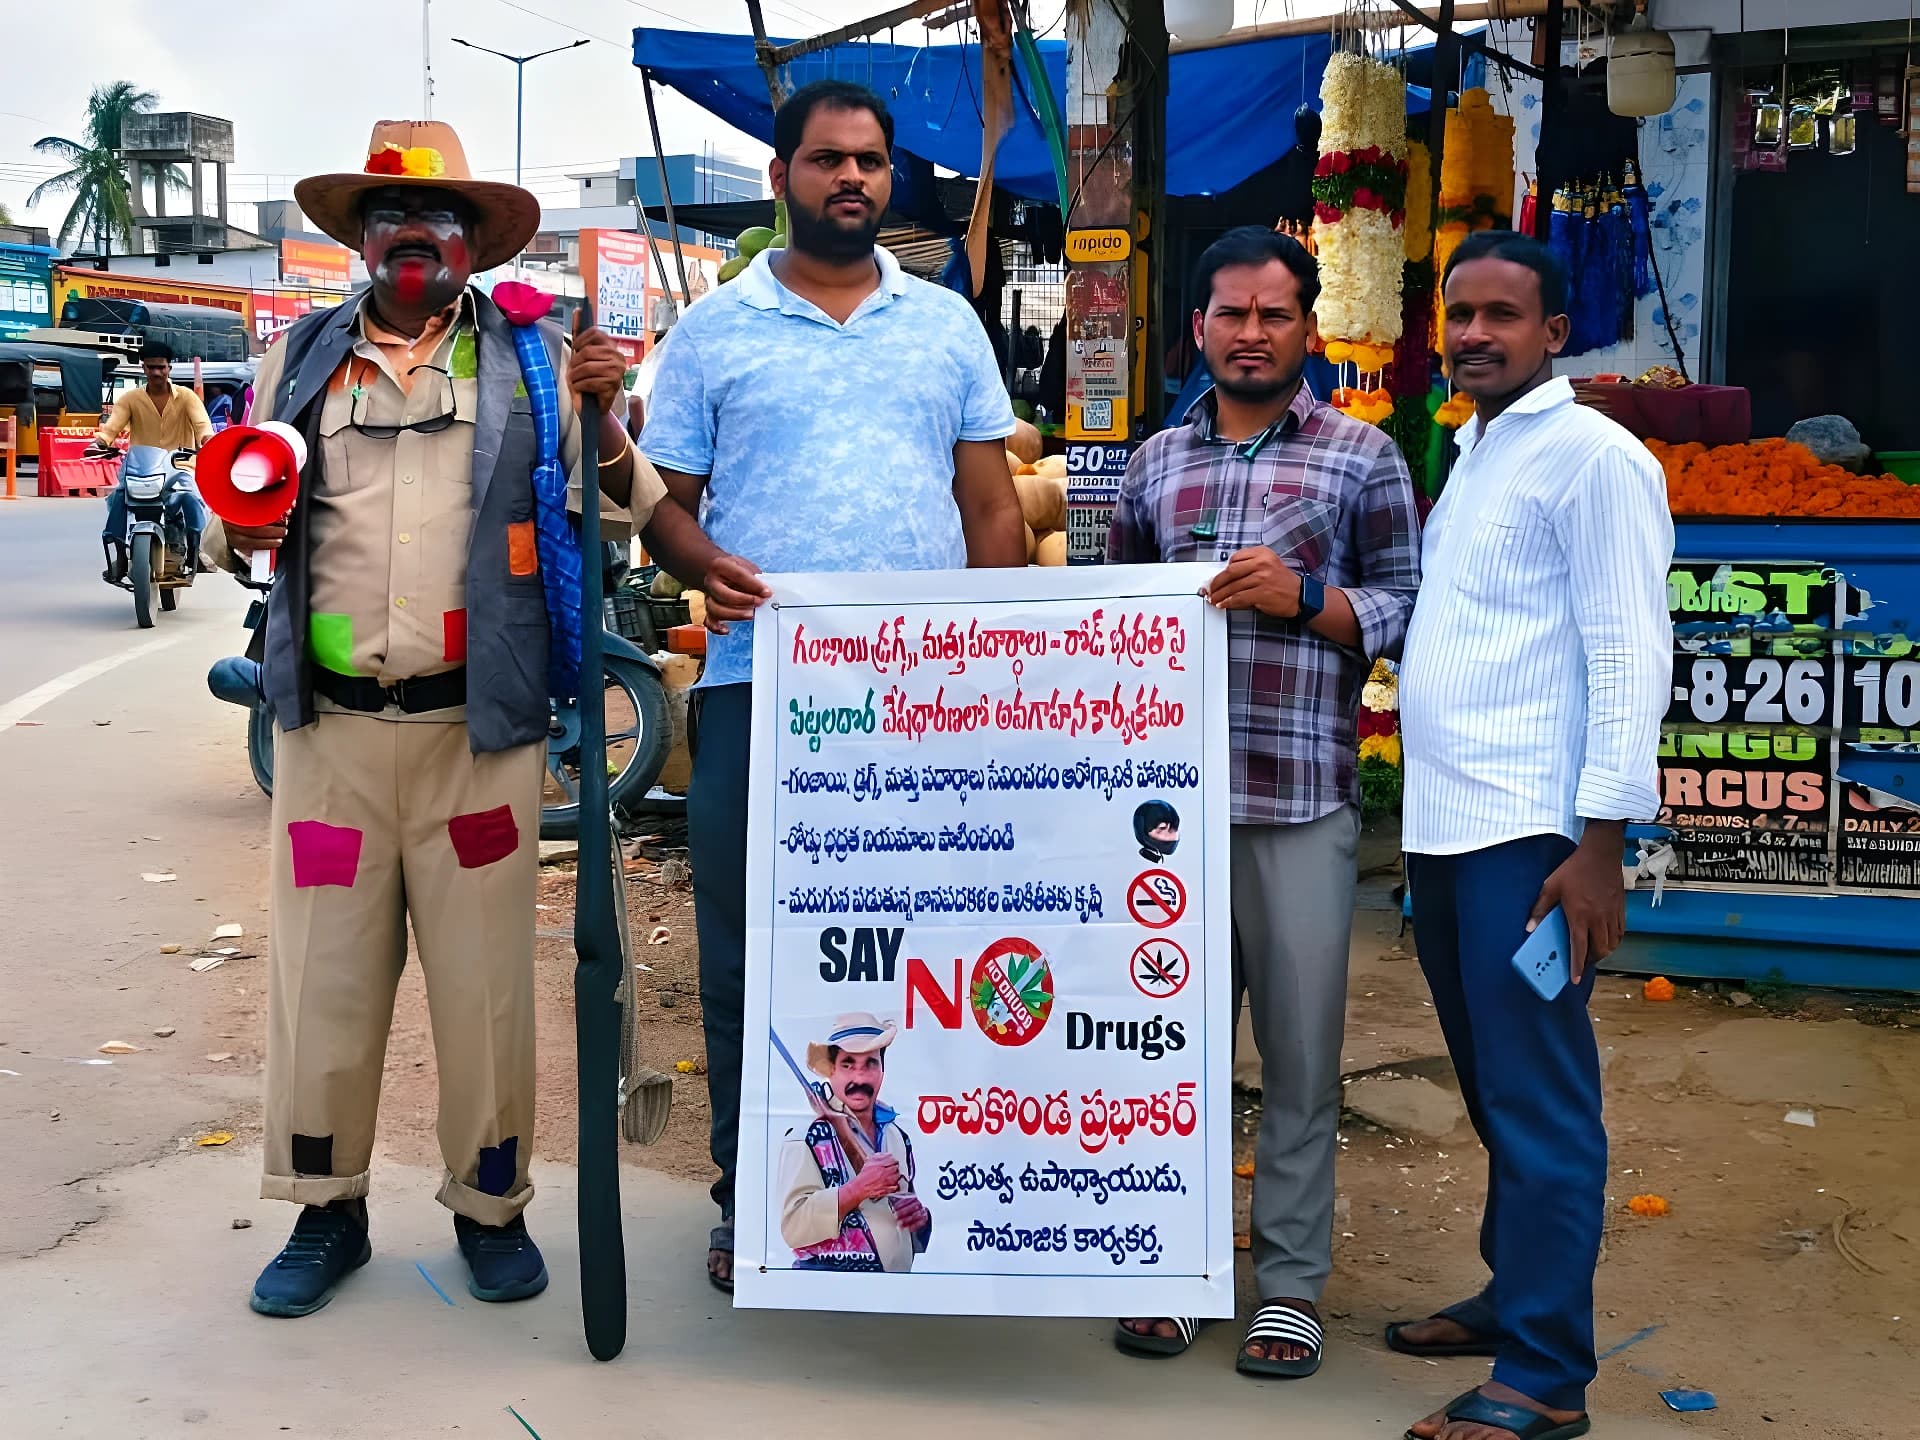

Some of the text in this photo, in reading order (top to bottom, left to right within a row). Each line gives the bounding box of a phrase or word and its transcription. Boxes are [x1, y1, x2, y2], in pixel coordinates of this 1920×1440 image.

[922, 619, 966, 675] మత్తు
[1064, 609, 1105, 657] రోడ్
[996, 688, 1087, 738] అవగాహన
[1090, 682, 1184, 745] కార్యక్రమం
[885, 766, 920, 803] మత్తు
[987, 759, 1059, 791] సేవించడం
[1657, 767, 1825, 811] RCUS
[824, 826, 860, 863] భద్రత
[862, 826, 935, 852] నియమాలు
[938, 821, 1015, 853] పాటించండి
[1844, 818, 1903, 832] DAILY
[819, 927, 904, 983] SAY
[1066, 1012, 1186, 1061] Drugs
[917, 1081, 1197, 1154] రాచకొండ ప్రభాకర్
[936, 1160, 1014, 1204] ప్రభుత్వ
[967, 1220, 1067, 1253] సామాజిక
